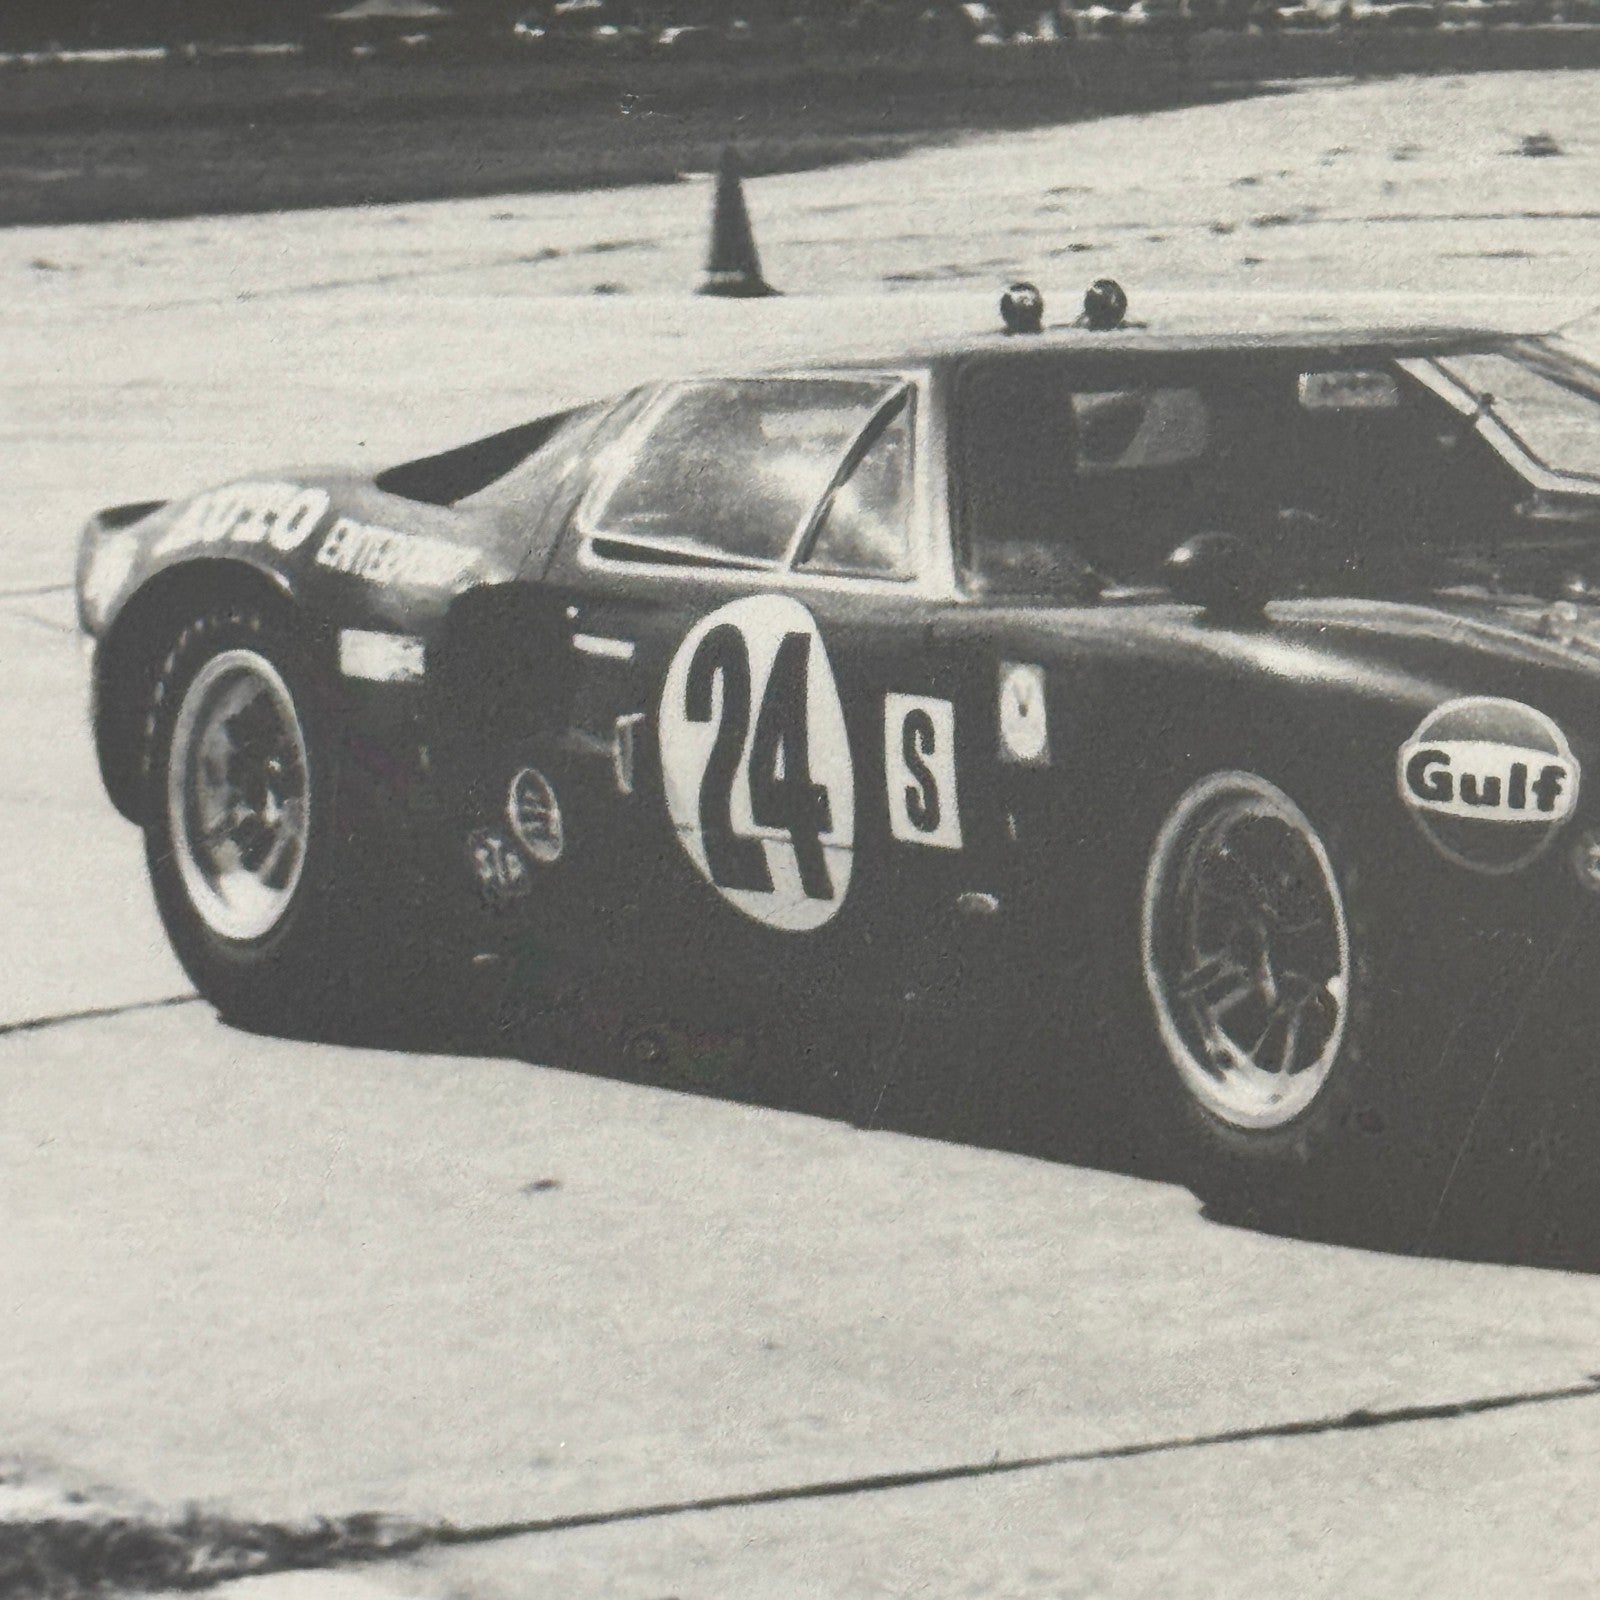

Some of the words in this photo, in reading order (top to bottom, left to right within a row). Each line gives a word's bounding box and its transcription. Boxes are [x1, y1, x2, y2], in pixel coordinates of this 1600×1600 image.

[684, 623, 834, 900] 24
[902, 708, 941, 833] S
[1406, 749, 1567, 813] Gulf
